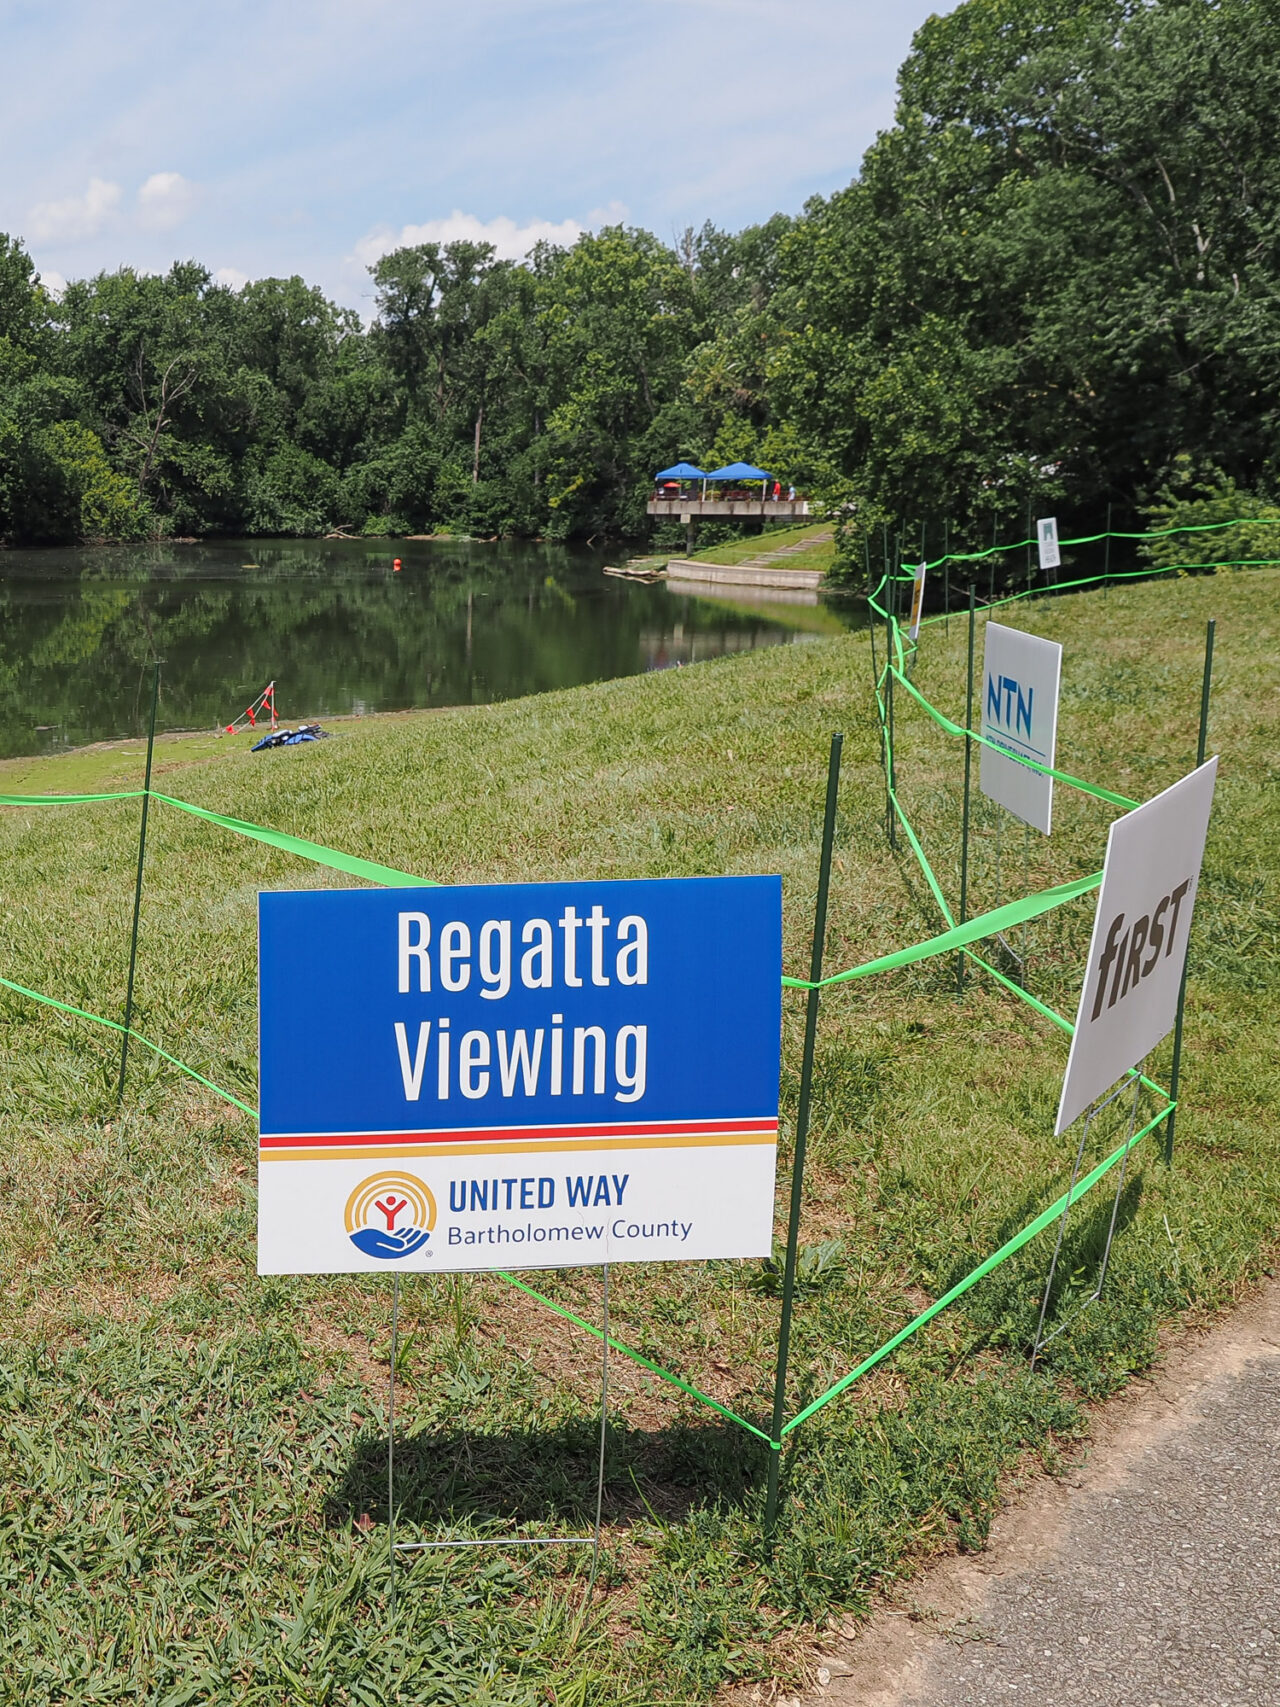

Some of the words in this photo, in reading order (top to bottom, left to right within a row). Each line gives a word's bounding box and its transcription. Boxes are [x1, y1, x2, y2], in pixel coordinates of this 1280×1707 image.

[986, 672, 1034, 740] NTN
[397, 905, 648, 1000] Regatta
[394, 1013, 648, 1103] Viewing
[449, 1177, 555, 1213] UNITED
[565, 1174, 630, 1208] WAY
[448, 1222, 605, 1246] Bartholomew
[612, 1219, 693, 1242] County
